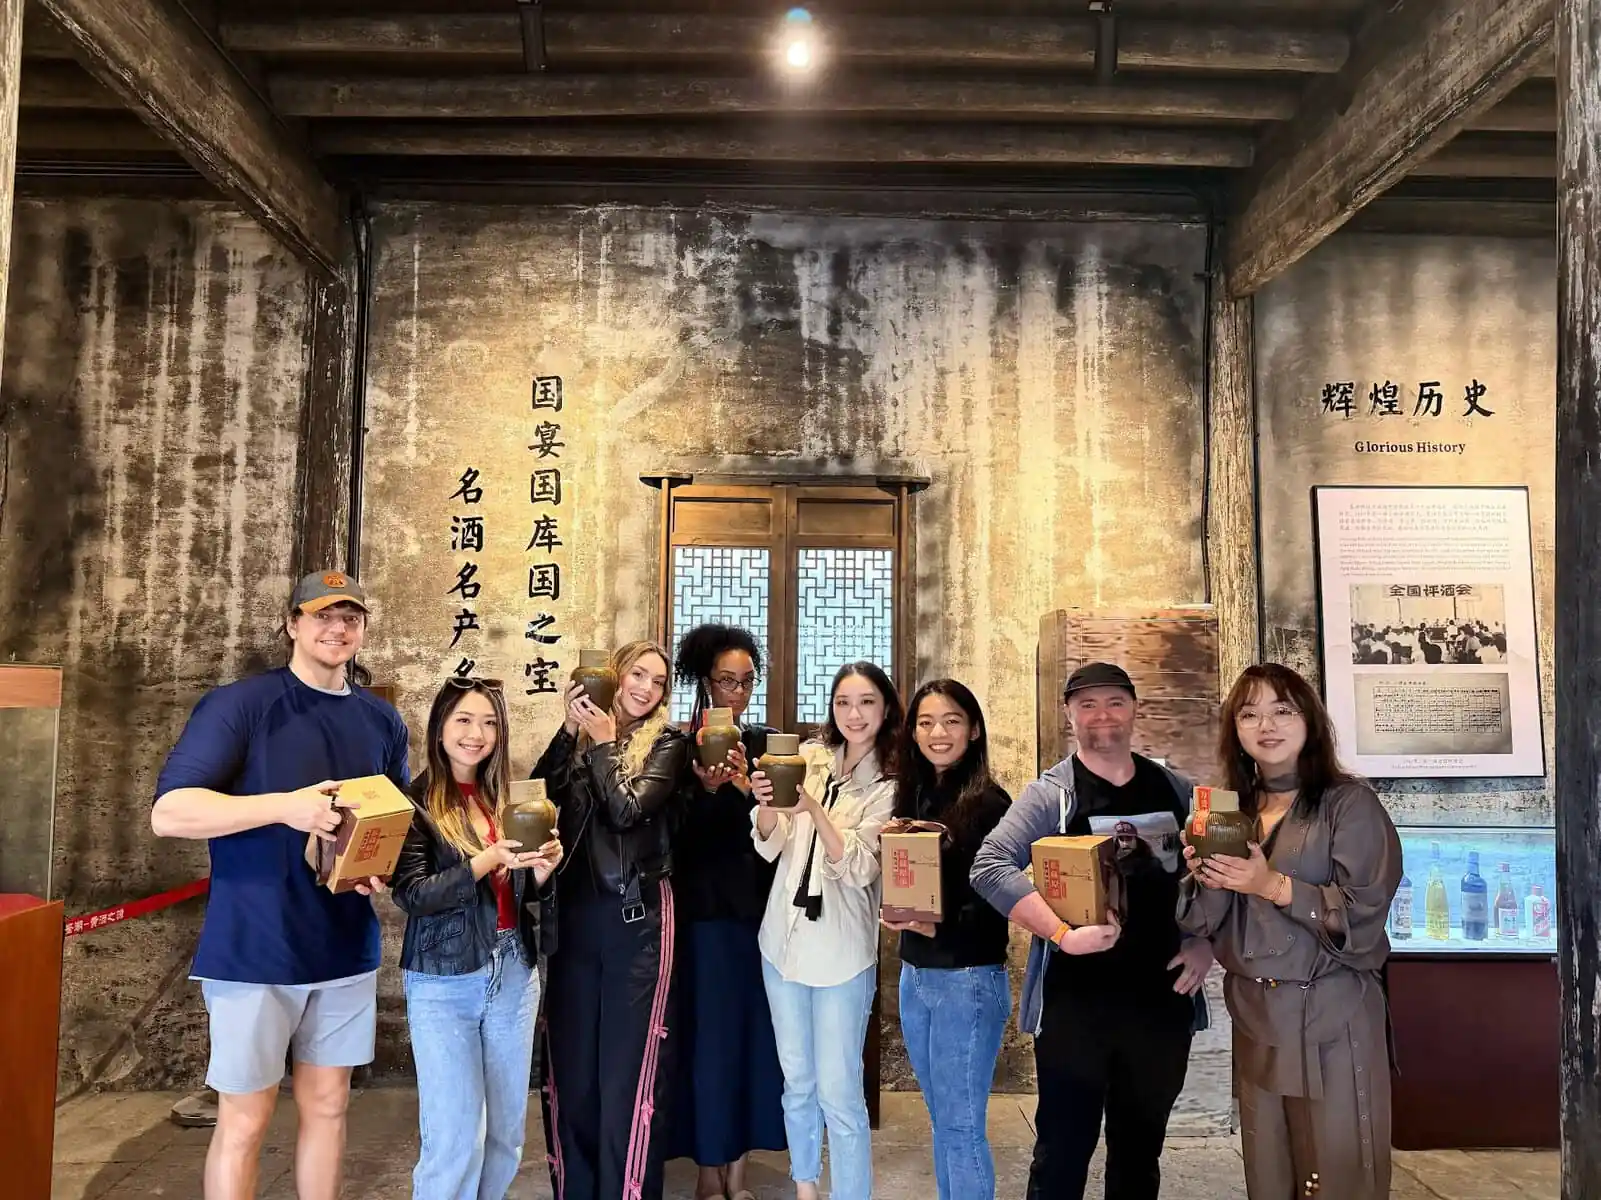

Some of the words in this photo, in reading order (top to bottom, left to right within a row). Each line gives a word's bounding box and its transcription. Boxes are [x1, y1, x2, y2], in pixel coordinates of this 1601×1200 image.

[1321, 378, 1495, 418] 辉煌历史
[1354, 441, 1414, 453] Glorious
[1417, 441, 1466, 454] History
[525, 375, 565, 695] 国宴国库国之宝
[1389, 584, 1473, 598] 全国评酒会
